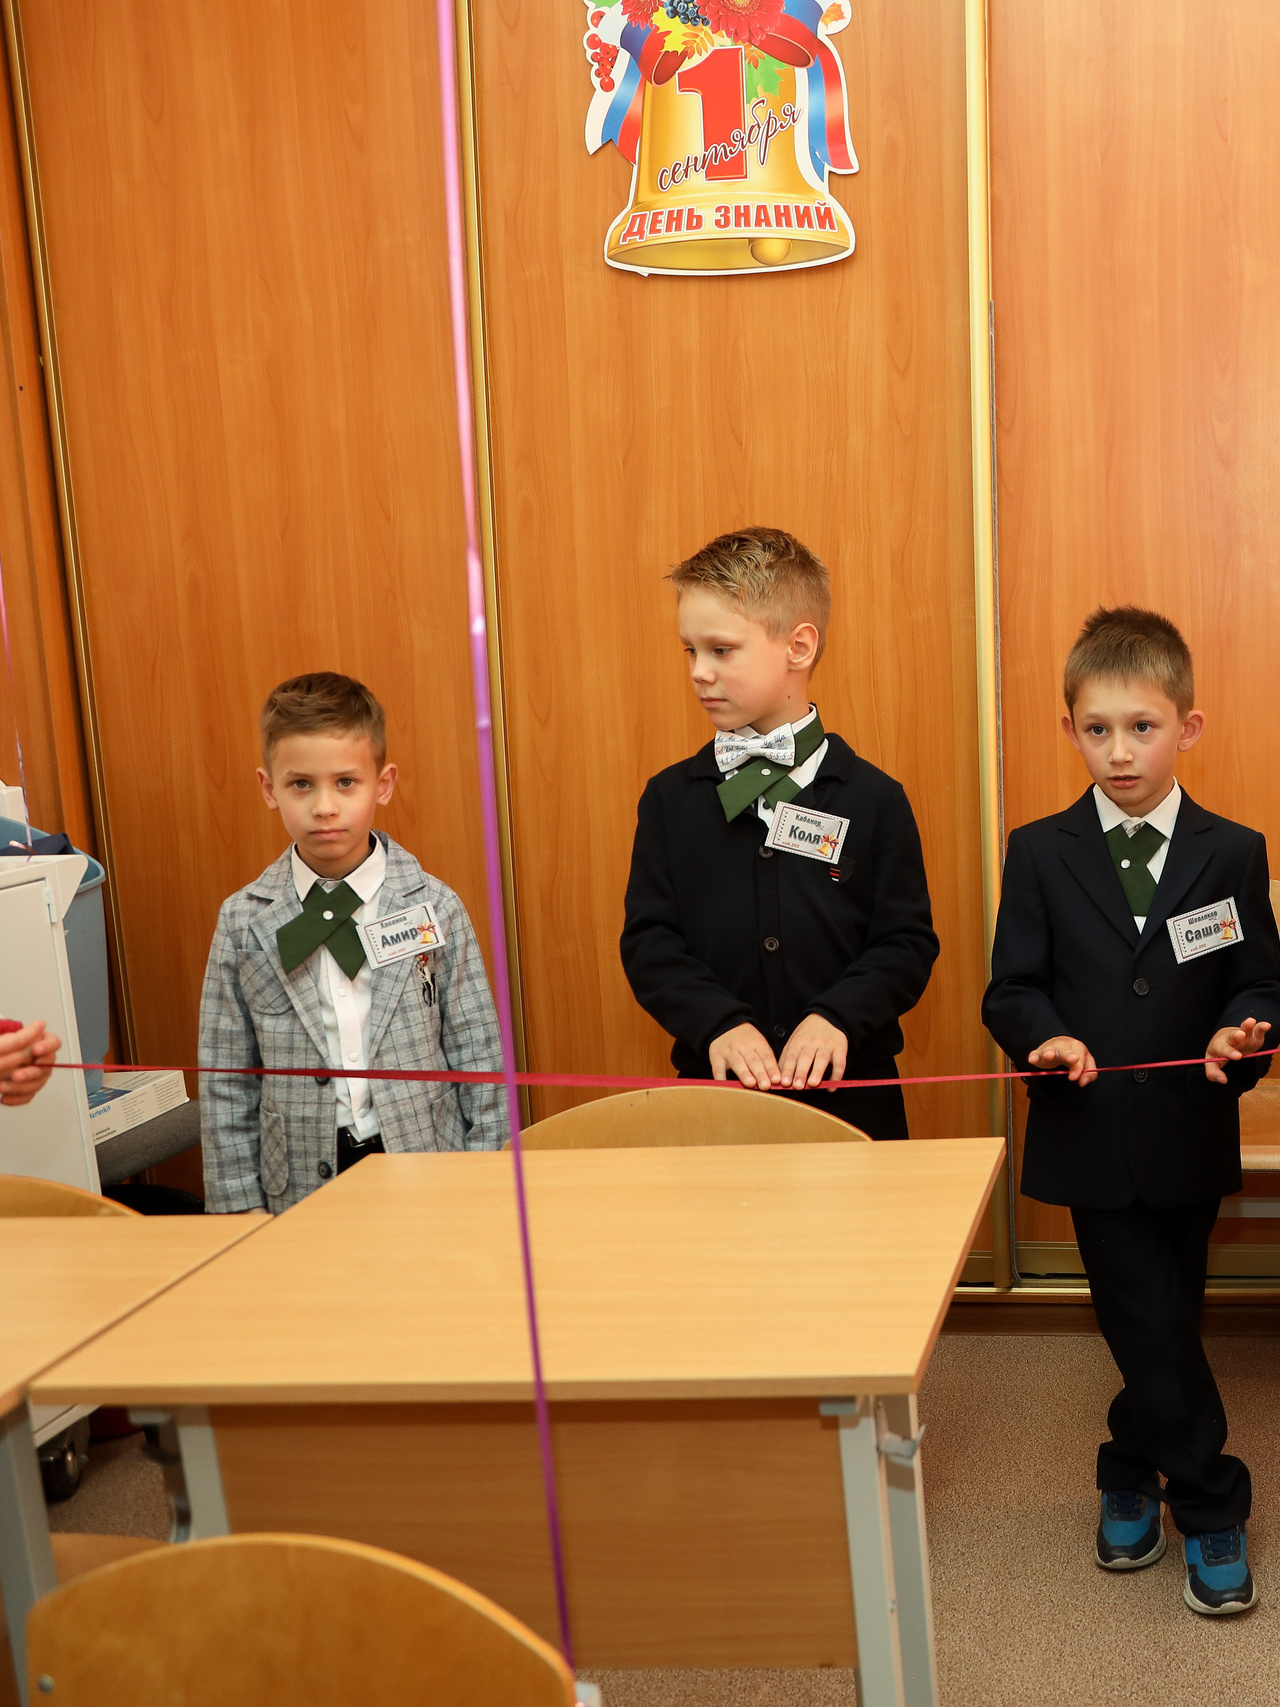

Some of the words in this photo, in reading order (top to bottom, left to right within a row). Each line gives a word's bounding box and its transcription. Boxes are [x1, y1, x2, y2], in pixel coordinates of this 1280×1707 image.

[675, 46, 748, 183] 1
[659, 98, 802, 192] сентября
[620, 207, 703, 243] ДЕНЬ
[714, 201, 838, 232] ЗНАНИЙ
[788, 824, 821, 846] Коля
[381, 927, 418, 949] Амир
[1185, 922, 1221, 944] Саша
